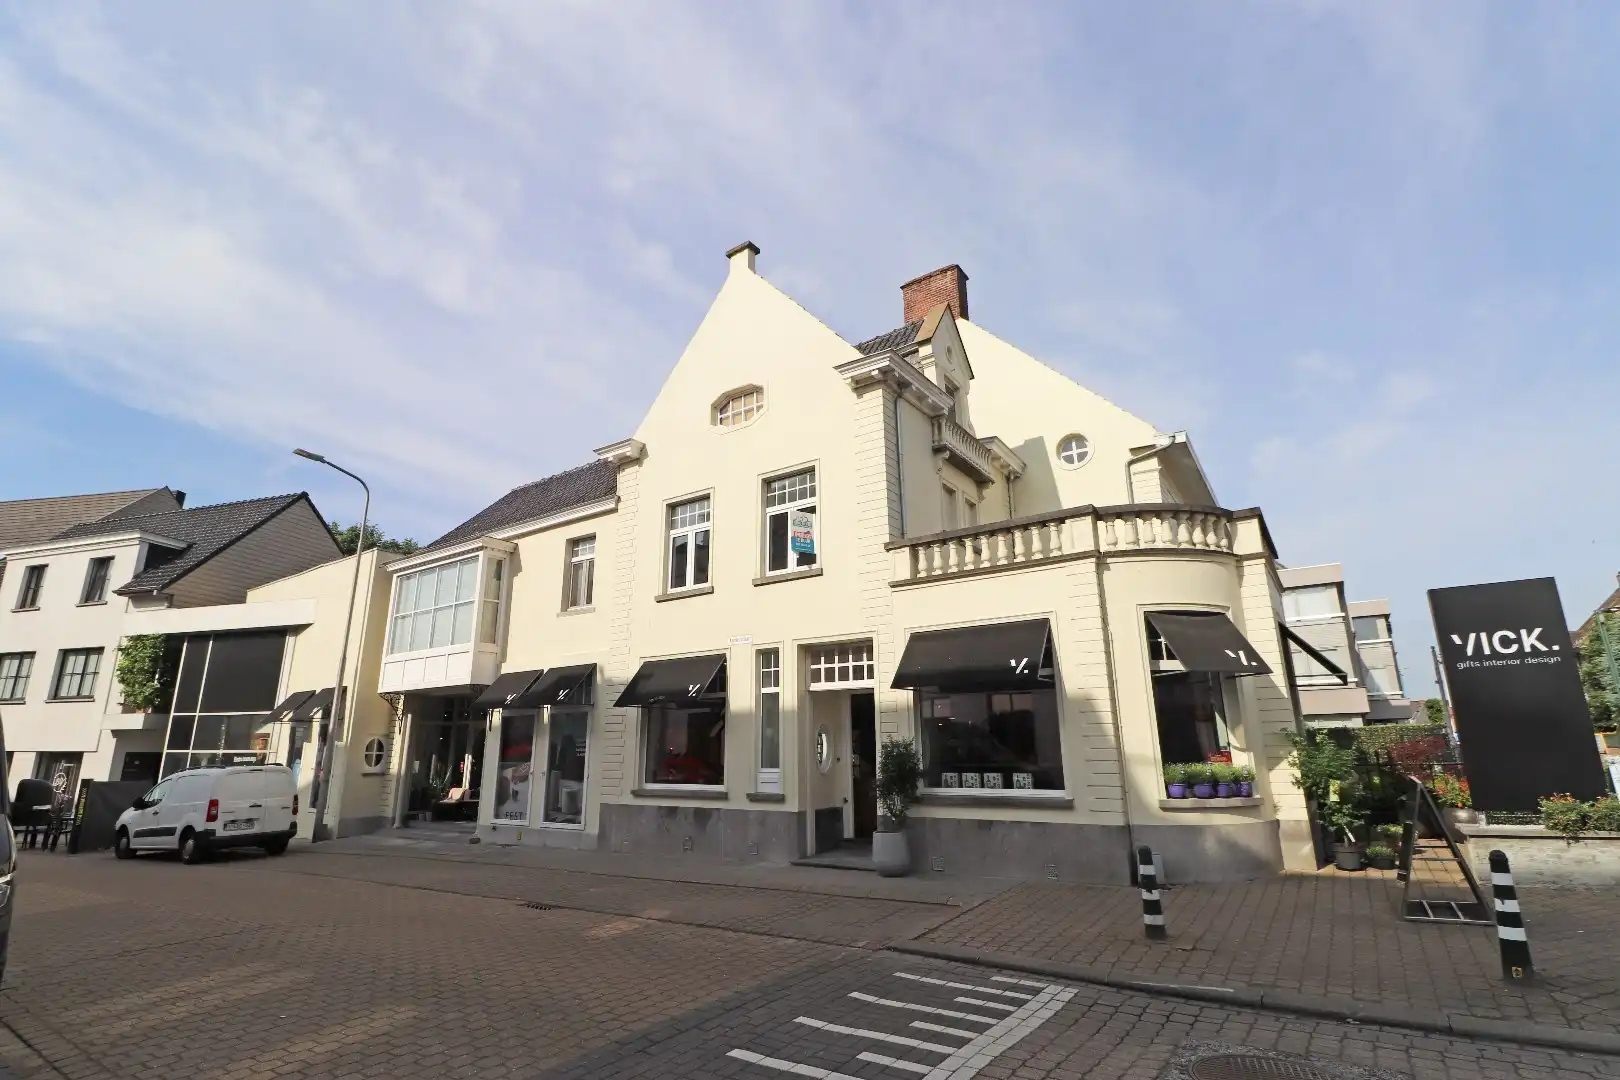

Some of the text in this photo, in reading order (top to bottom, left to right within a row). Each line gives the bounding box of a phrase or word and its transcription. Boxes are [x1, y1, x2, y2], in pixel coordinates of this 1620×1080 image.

[1450, 628, 1560, 656] VICK.
[1456, 656, 1561, 670] gifts interior design
